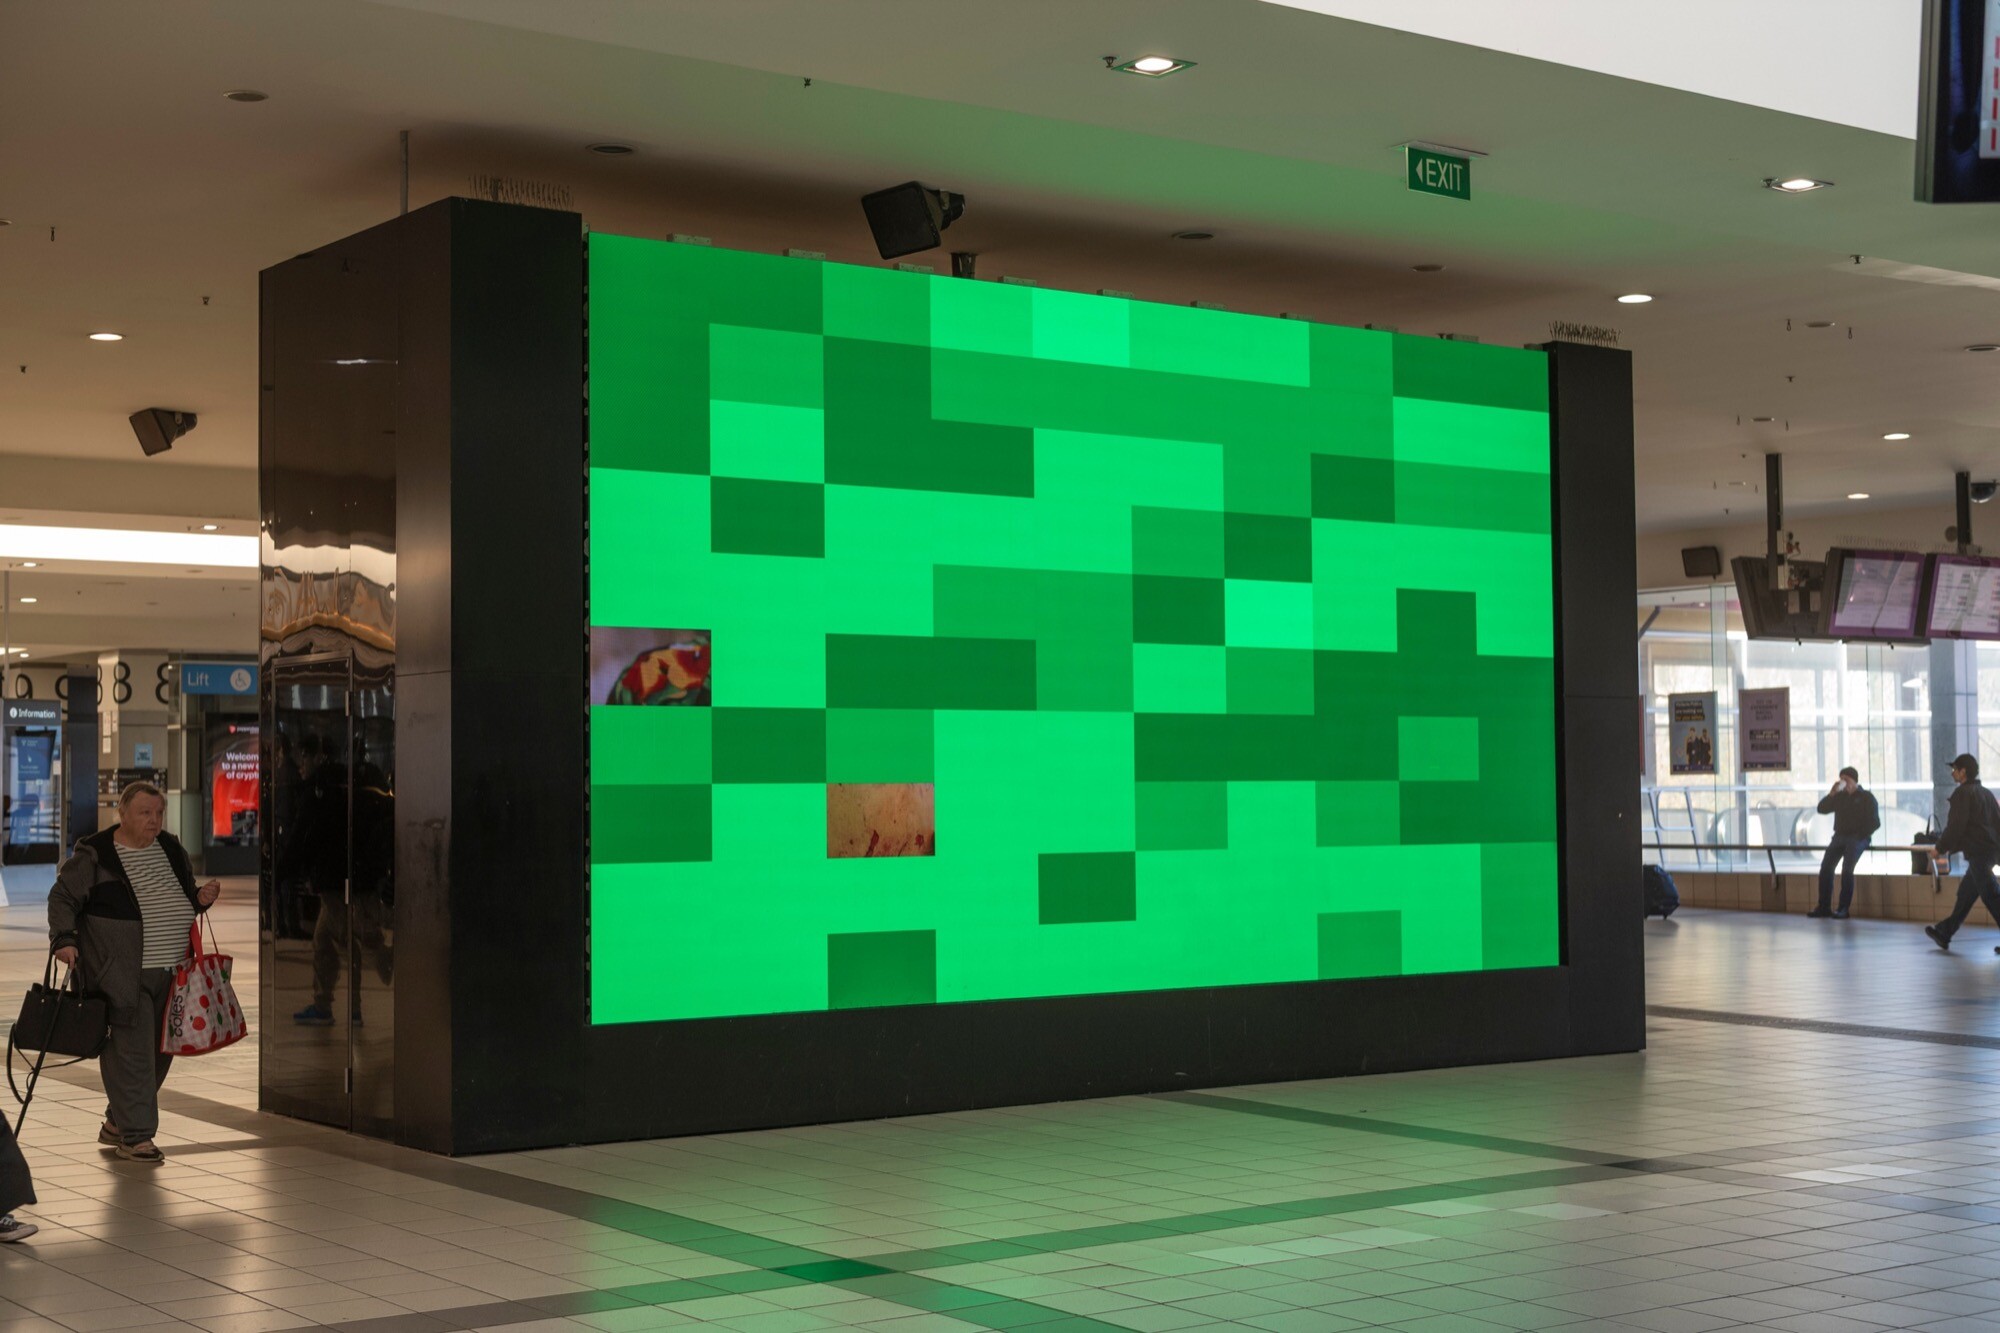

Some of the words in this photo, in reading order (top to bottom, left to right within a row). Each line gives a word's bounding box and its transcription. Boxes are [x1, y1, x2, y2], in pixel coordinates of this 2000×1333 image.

[1426, 158, 1463, 192] EXIT
[113, 661, 132, 704] 8
[187, 671, 209, 686] Lift
[19, 708, 56, 719] Information
[226, 752, 259, 761] Welcom
[221, 762, 231, 770] to
[226, 771, 235, 779] of
[236, 771, 259, 781] crypt
[171, 994, 183, 1038] coles
